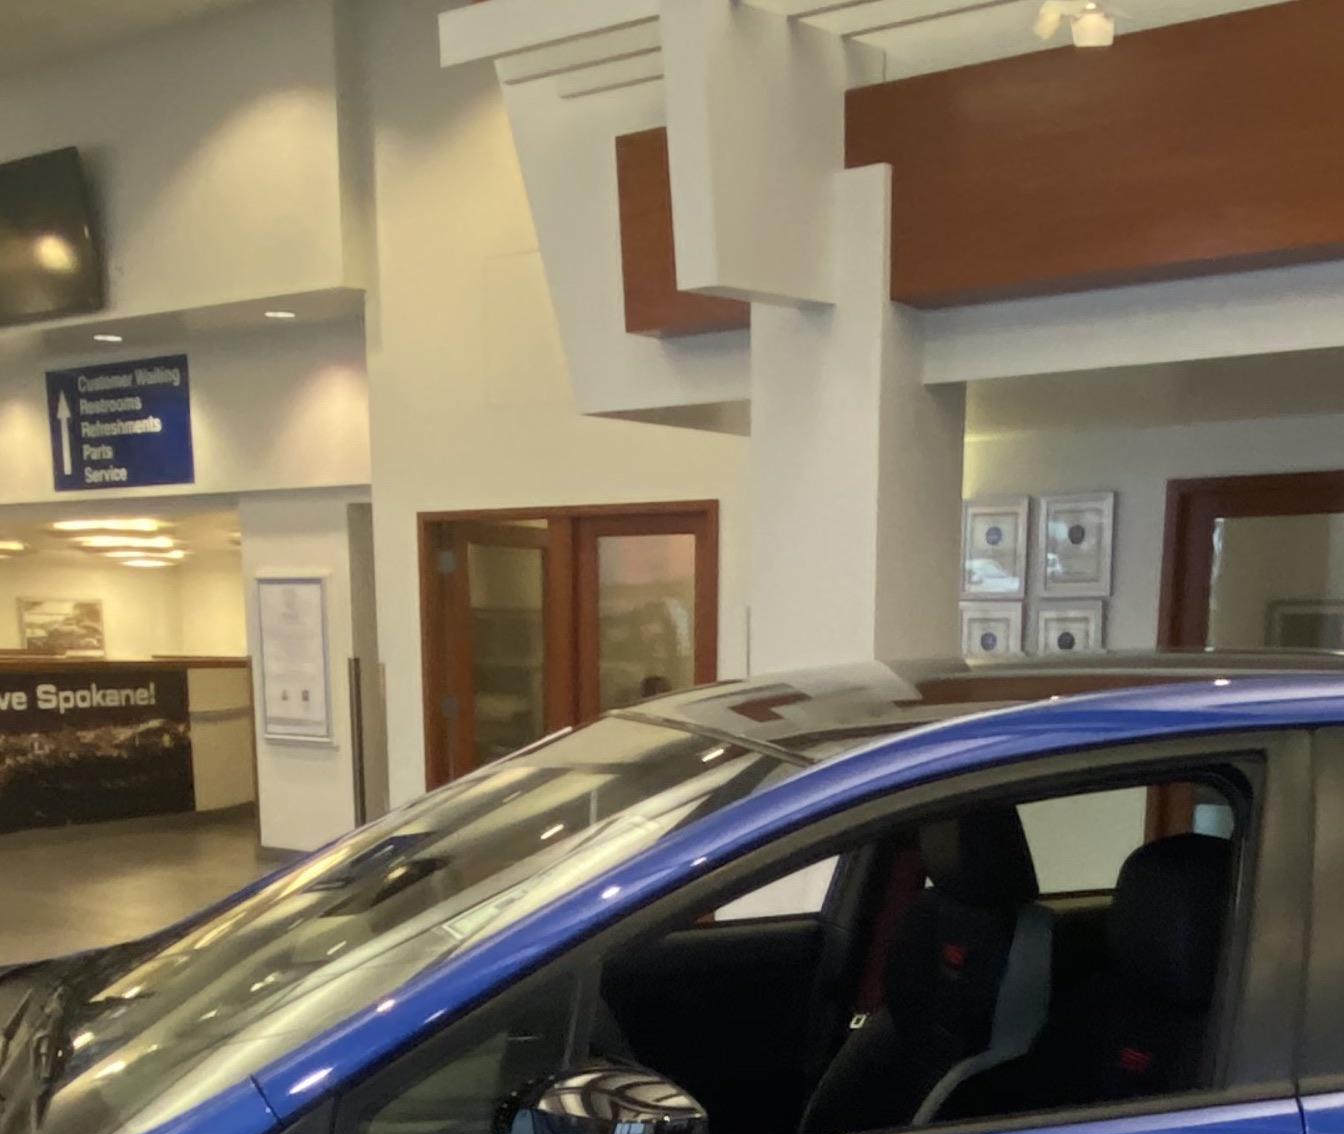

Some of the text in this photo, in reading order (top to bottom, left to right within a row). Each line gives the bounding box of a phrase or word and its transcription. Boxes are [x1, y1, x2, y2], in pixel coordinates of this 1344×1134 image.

[79, 396, 143, 416] Restrooms
[82, 444, 114, 461] Parts
[84, 464, 129, 484] Service
[37, 681, 156, 714] Spokane!
